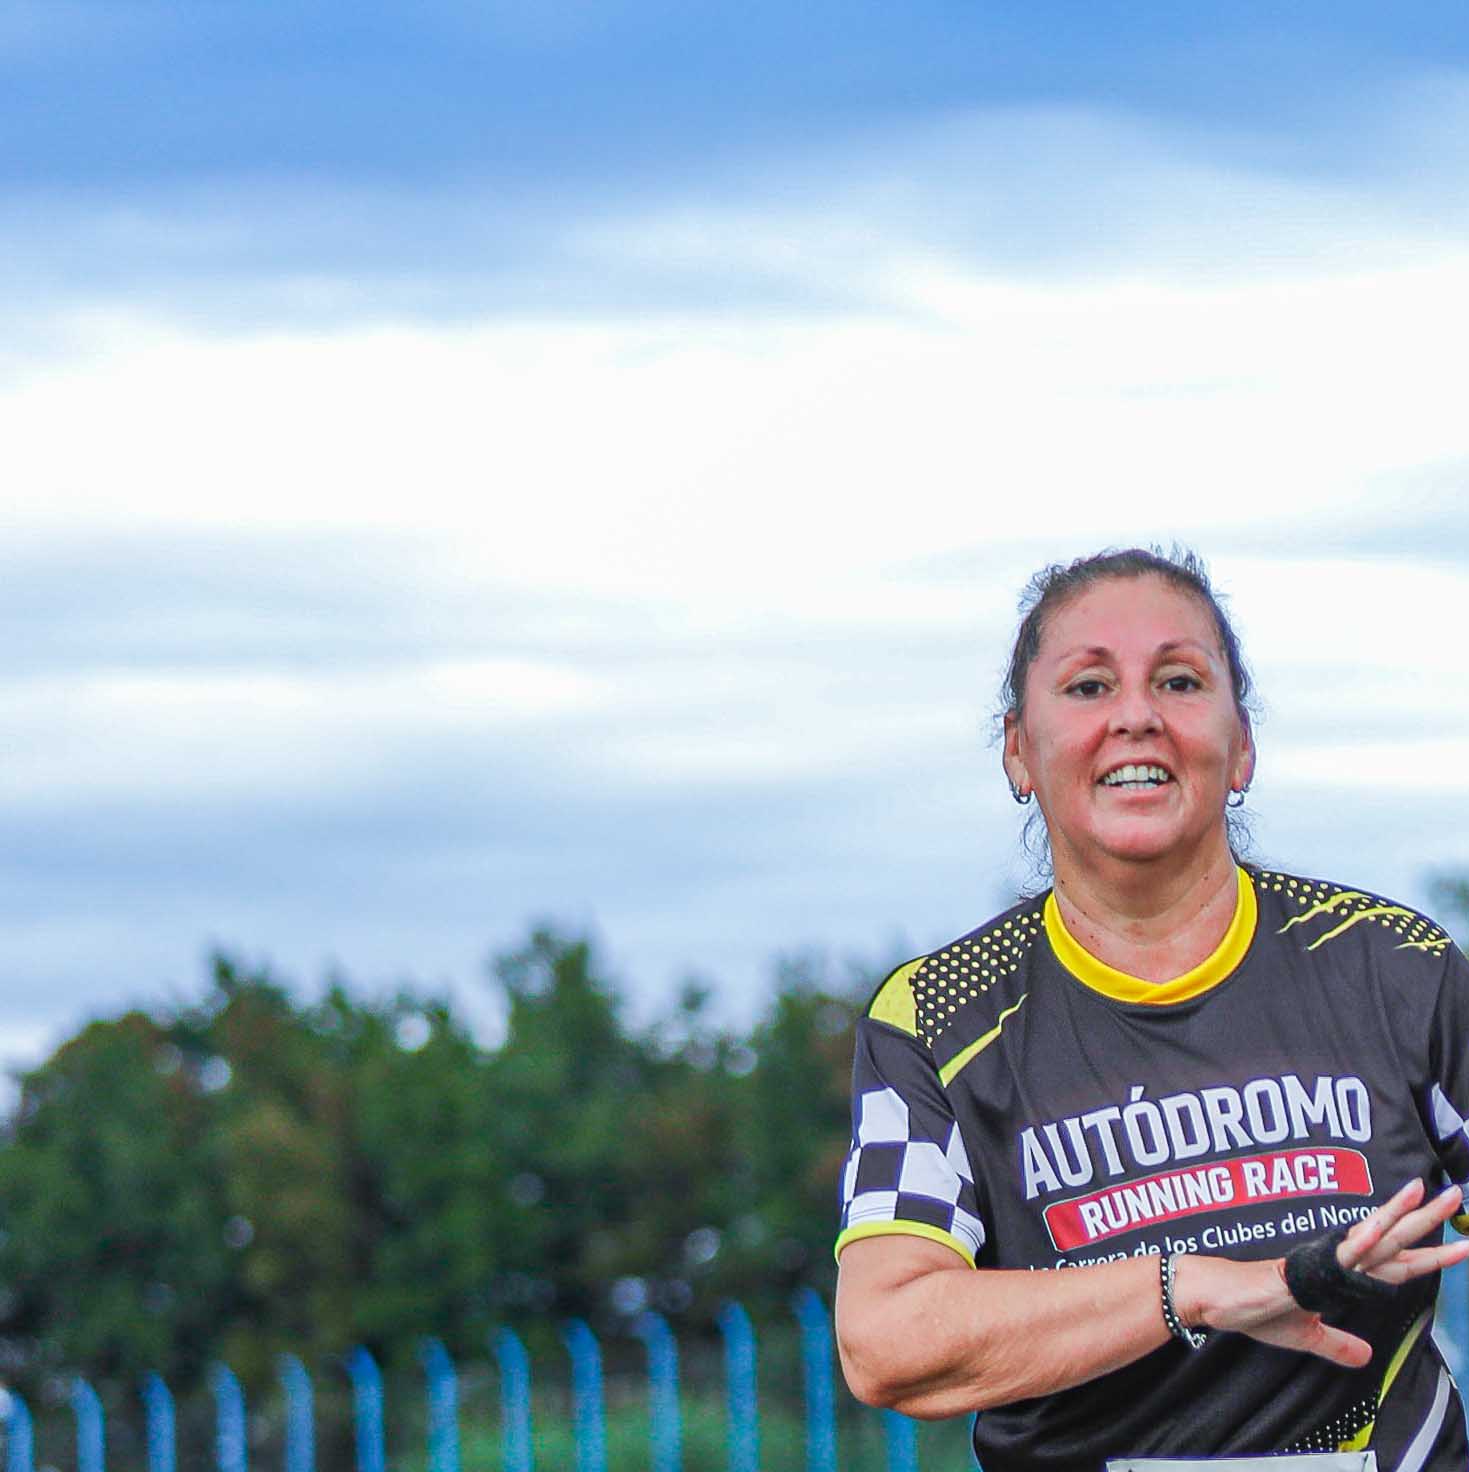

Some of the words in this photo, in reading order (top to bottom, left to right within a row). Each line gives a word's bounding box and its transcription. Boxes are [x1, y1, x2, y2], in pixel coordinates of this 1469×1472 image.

[1021, 1073, 1372, 1199] AUTÓDROMO
[1079, 1166, 1234, 1239] RUNNING
[1243, 1154, 1339, 1197] RACE
[1165, 1236, 1198, 1254] los
[1202, 1221, 1276, 1248] Clubes
[1281, 1209, 1316, 1234] del
